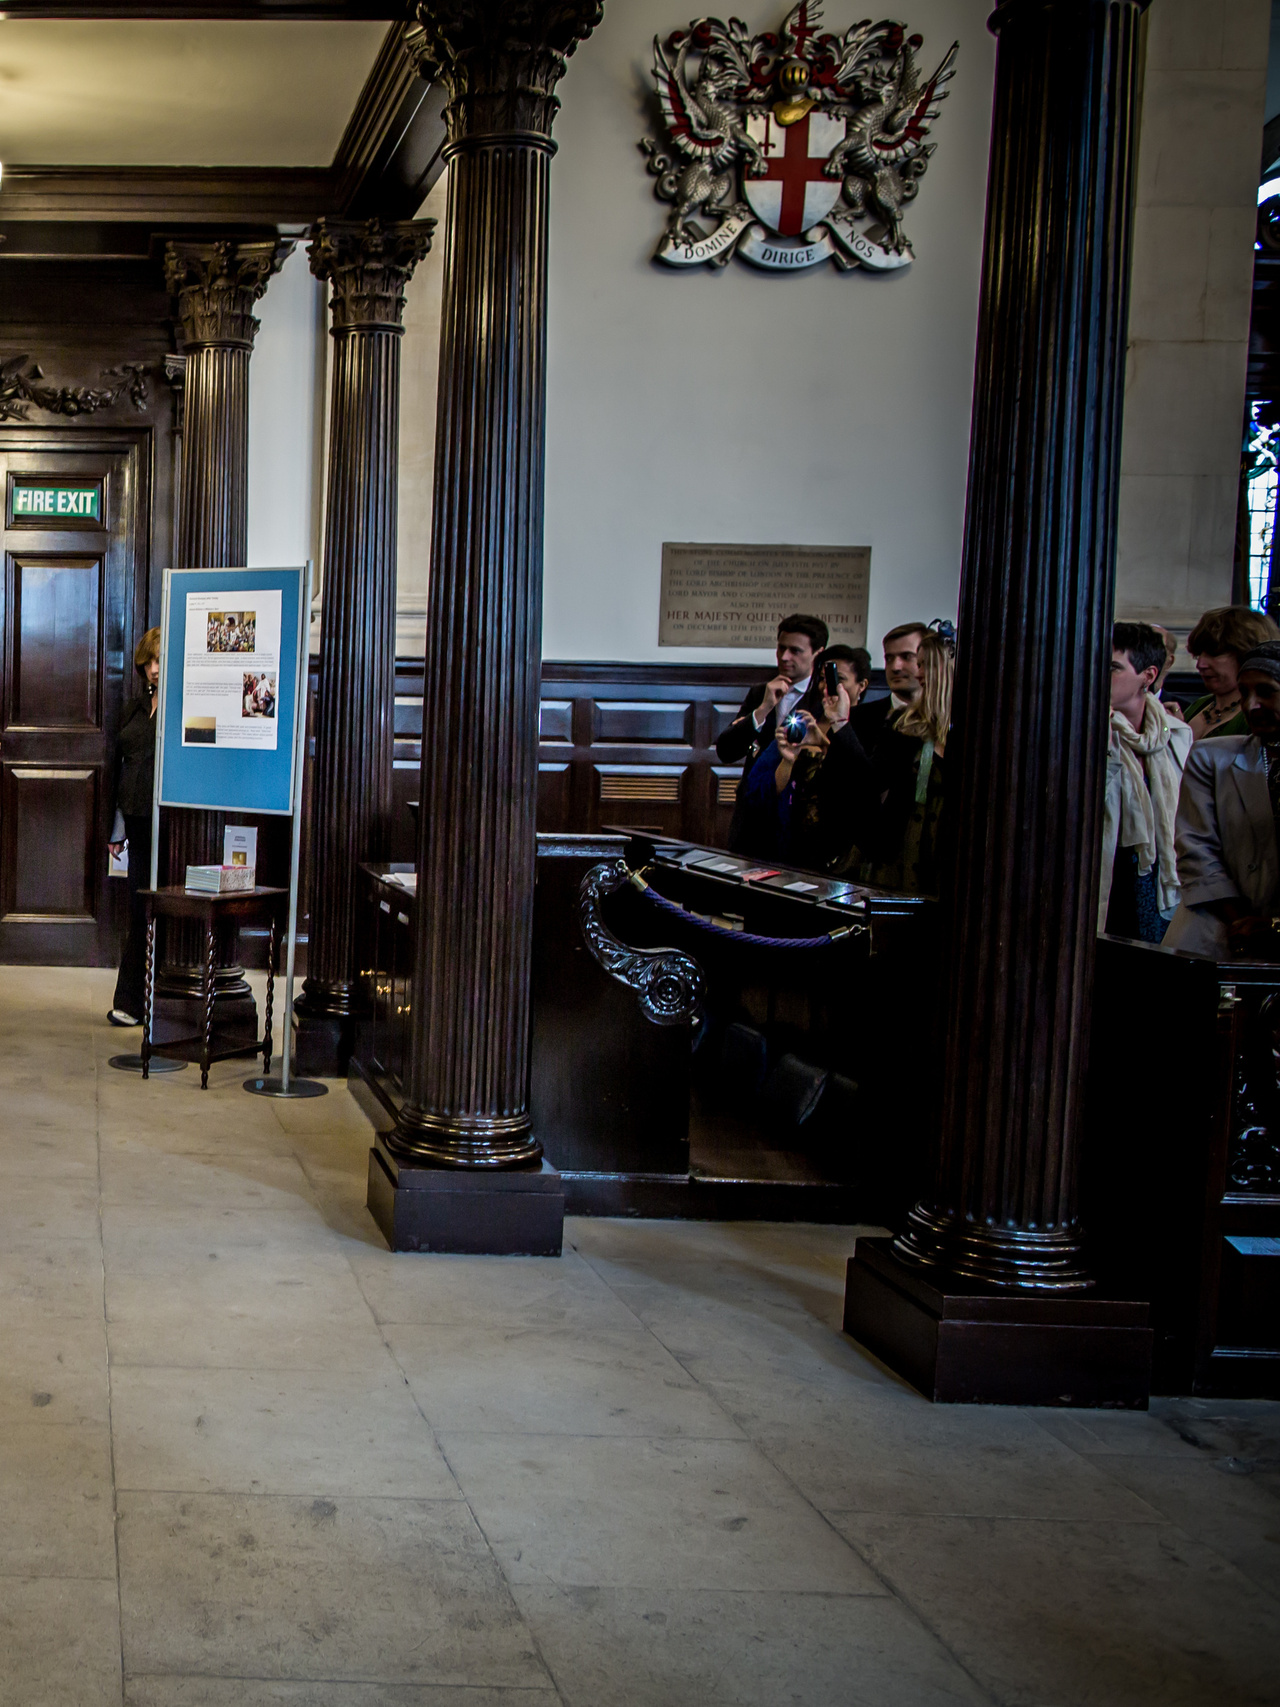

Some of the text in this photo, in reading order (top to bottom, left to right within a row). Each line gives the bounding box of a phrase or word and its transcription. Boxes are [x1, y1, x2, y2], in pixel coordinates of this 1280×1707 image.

[683, 223, 875, 264] DOMINE DIRIGE NOS
[18, 490, 95, 514] FIRE EXIT
[667, 610, 689, 620] HER
[694, 611, 743, 622] MAJESTY
[746, 612, 786, 622] QUEEN
[853, 614, 862, 624] II
[673, 623, 684, 631] ON
